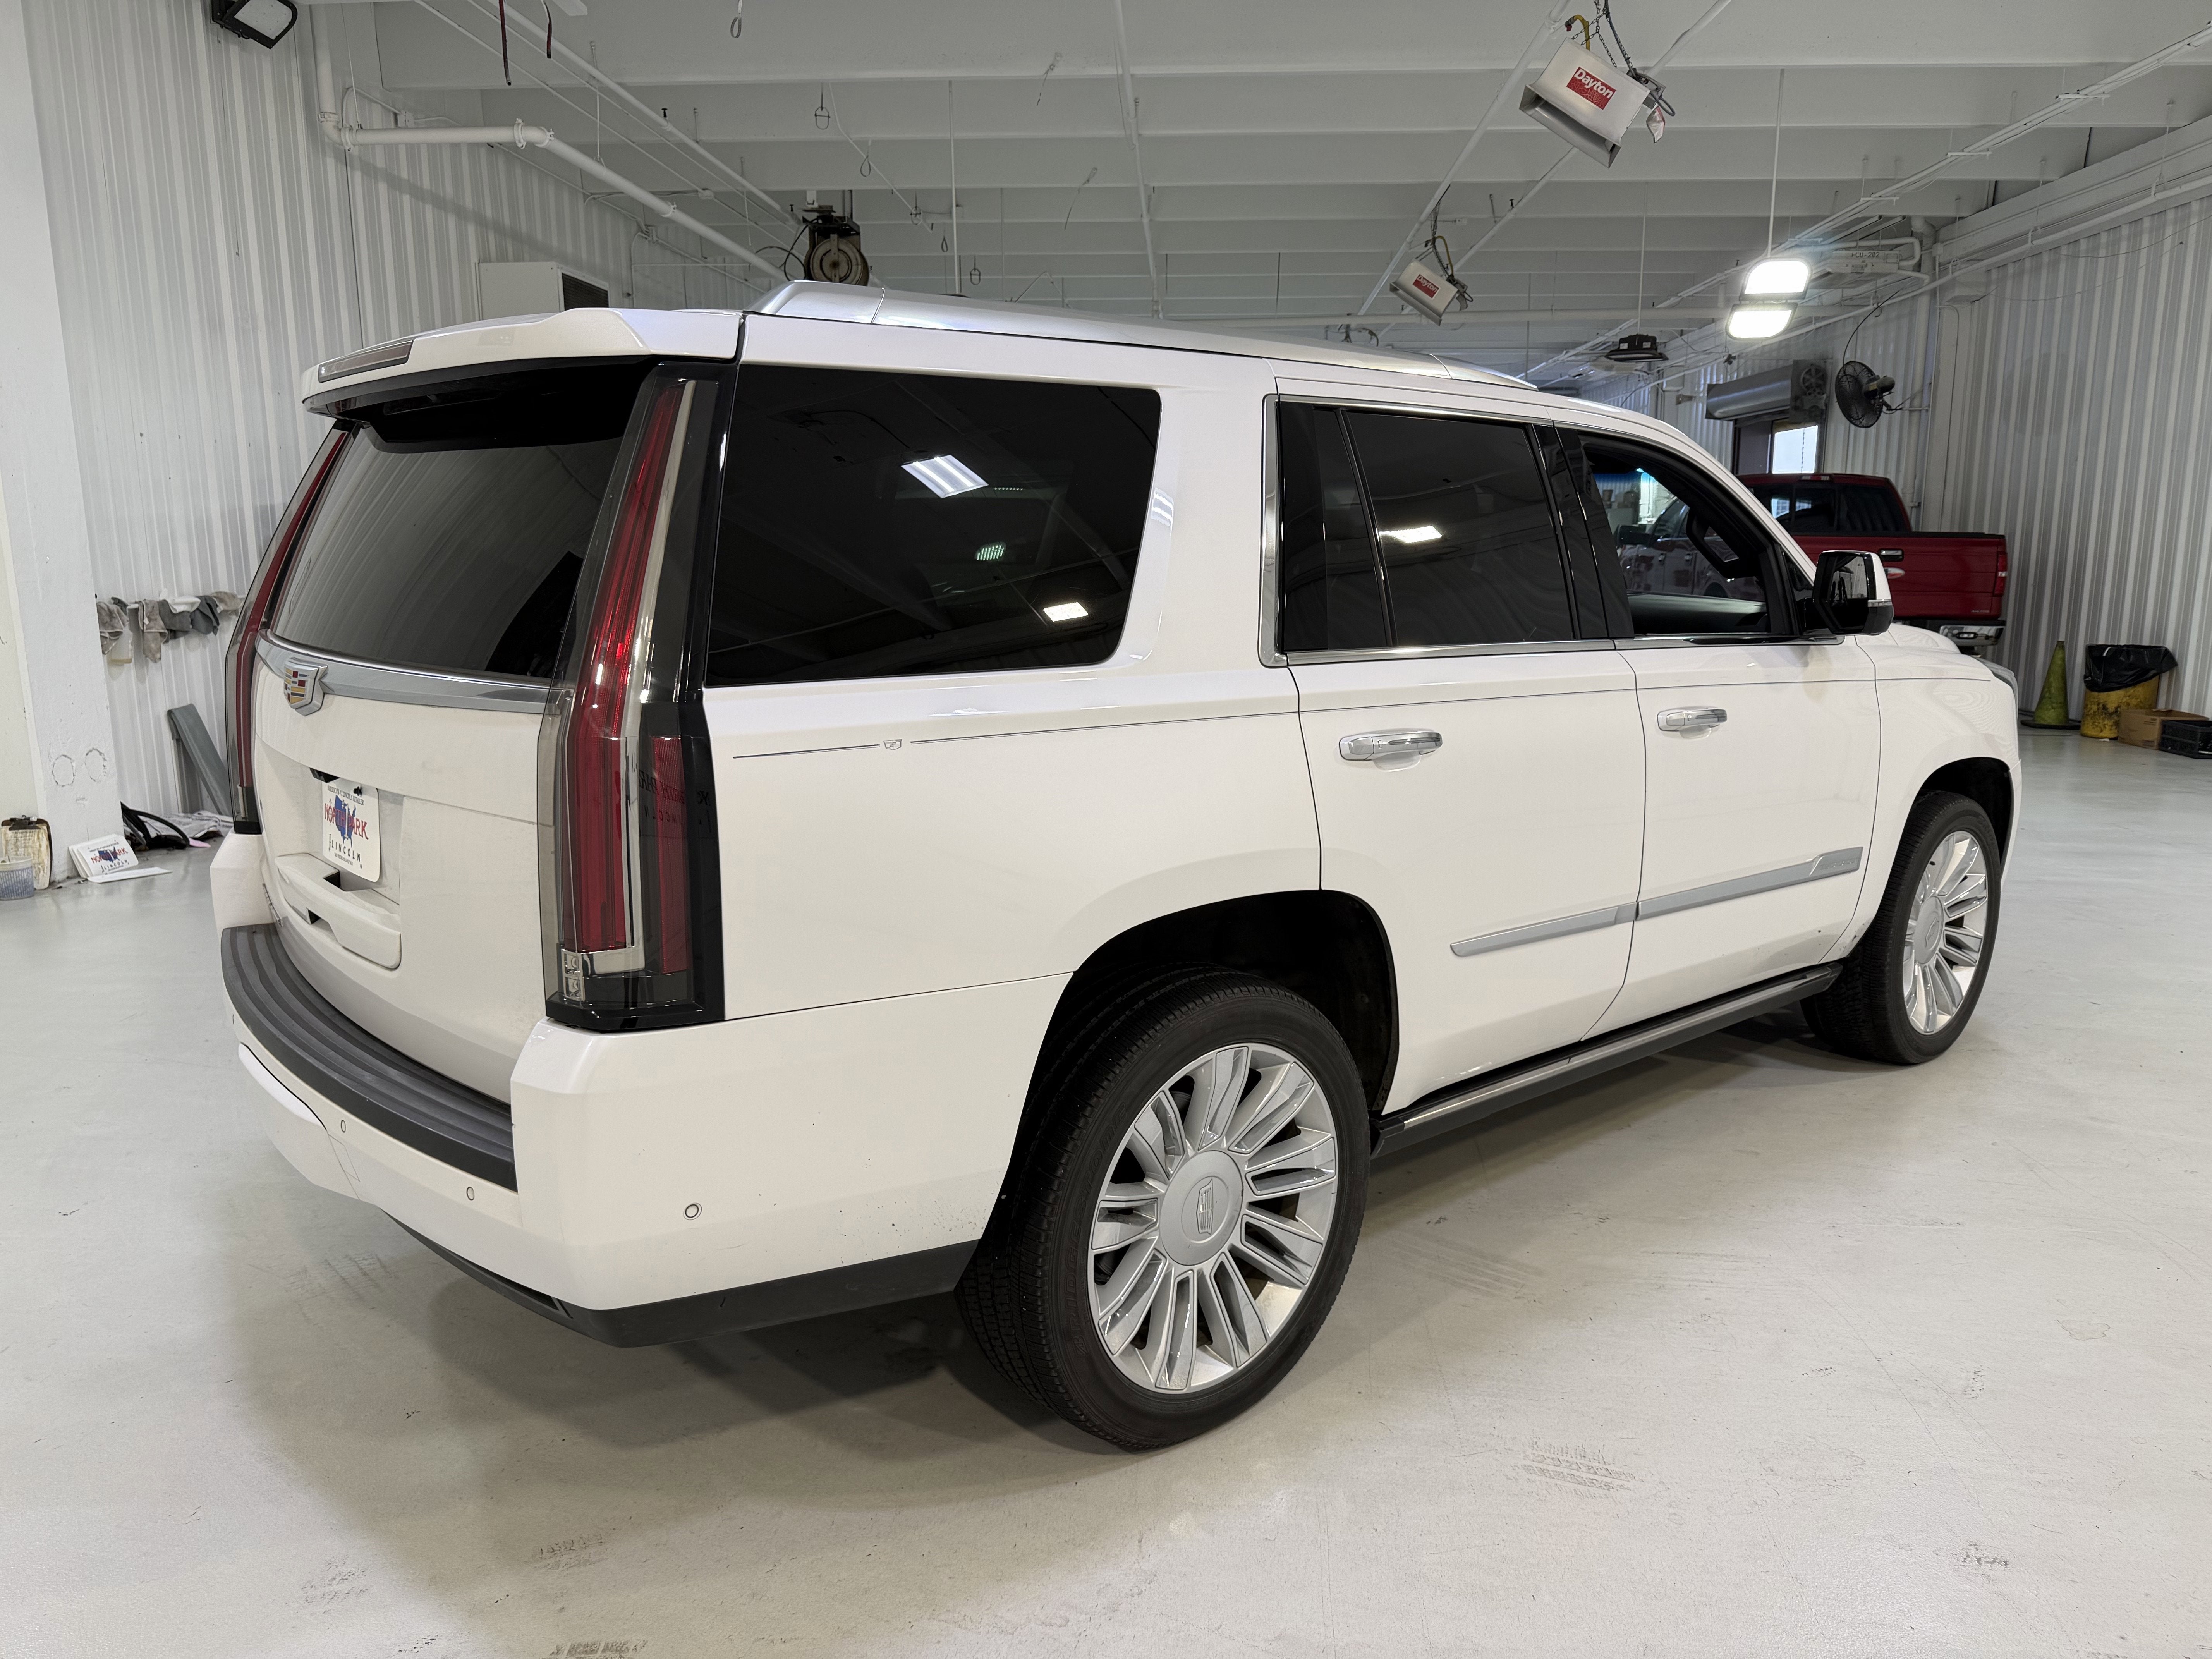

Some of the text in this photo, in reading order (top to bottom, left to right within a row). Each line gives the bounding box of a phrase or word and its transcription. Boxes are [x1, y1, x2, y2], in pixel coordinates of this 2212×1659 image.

[1573, 69, 1613, 98] Dayton
[1417, 275, 1438, 293] Dayton
[325, 802, 347, 828] NORTH
[331, 839, 361, 862] LINCOLN
[1066, 1102, 1127, 1355] BRIDGESTONE
